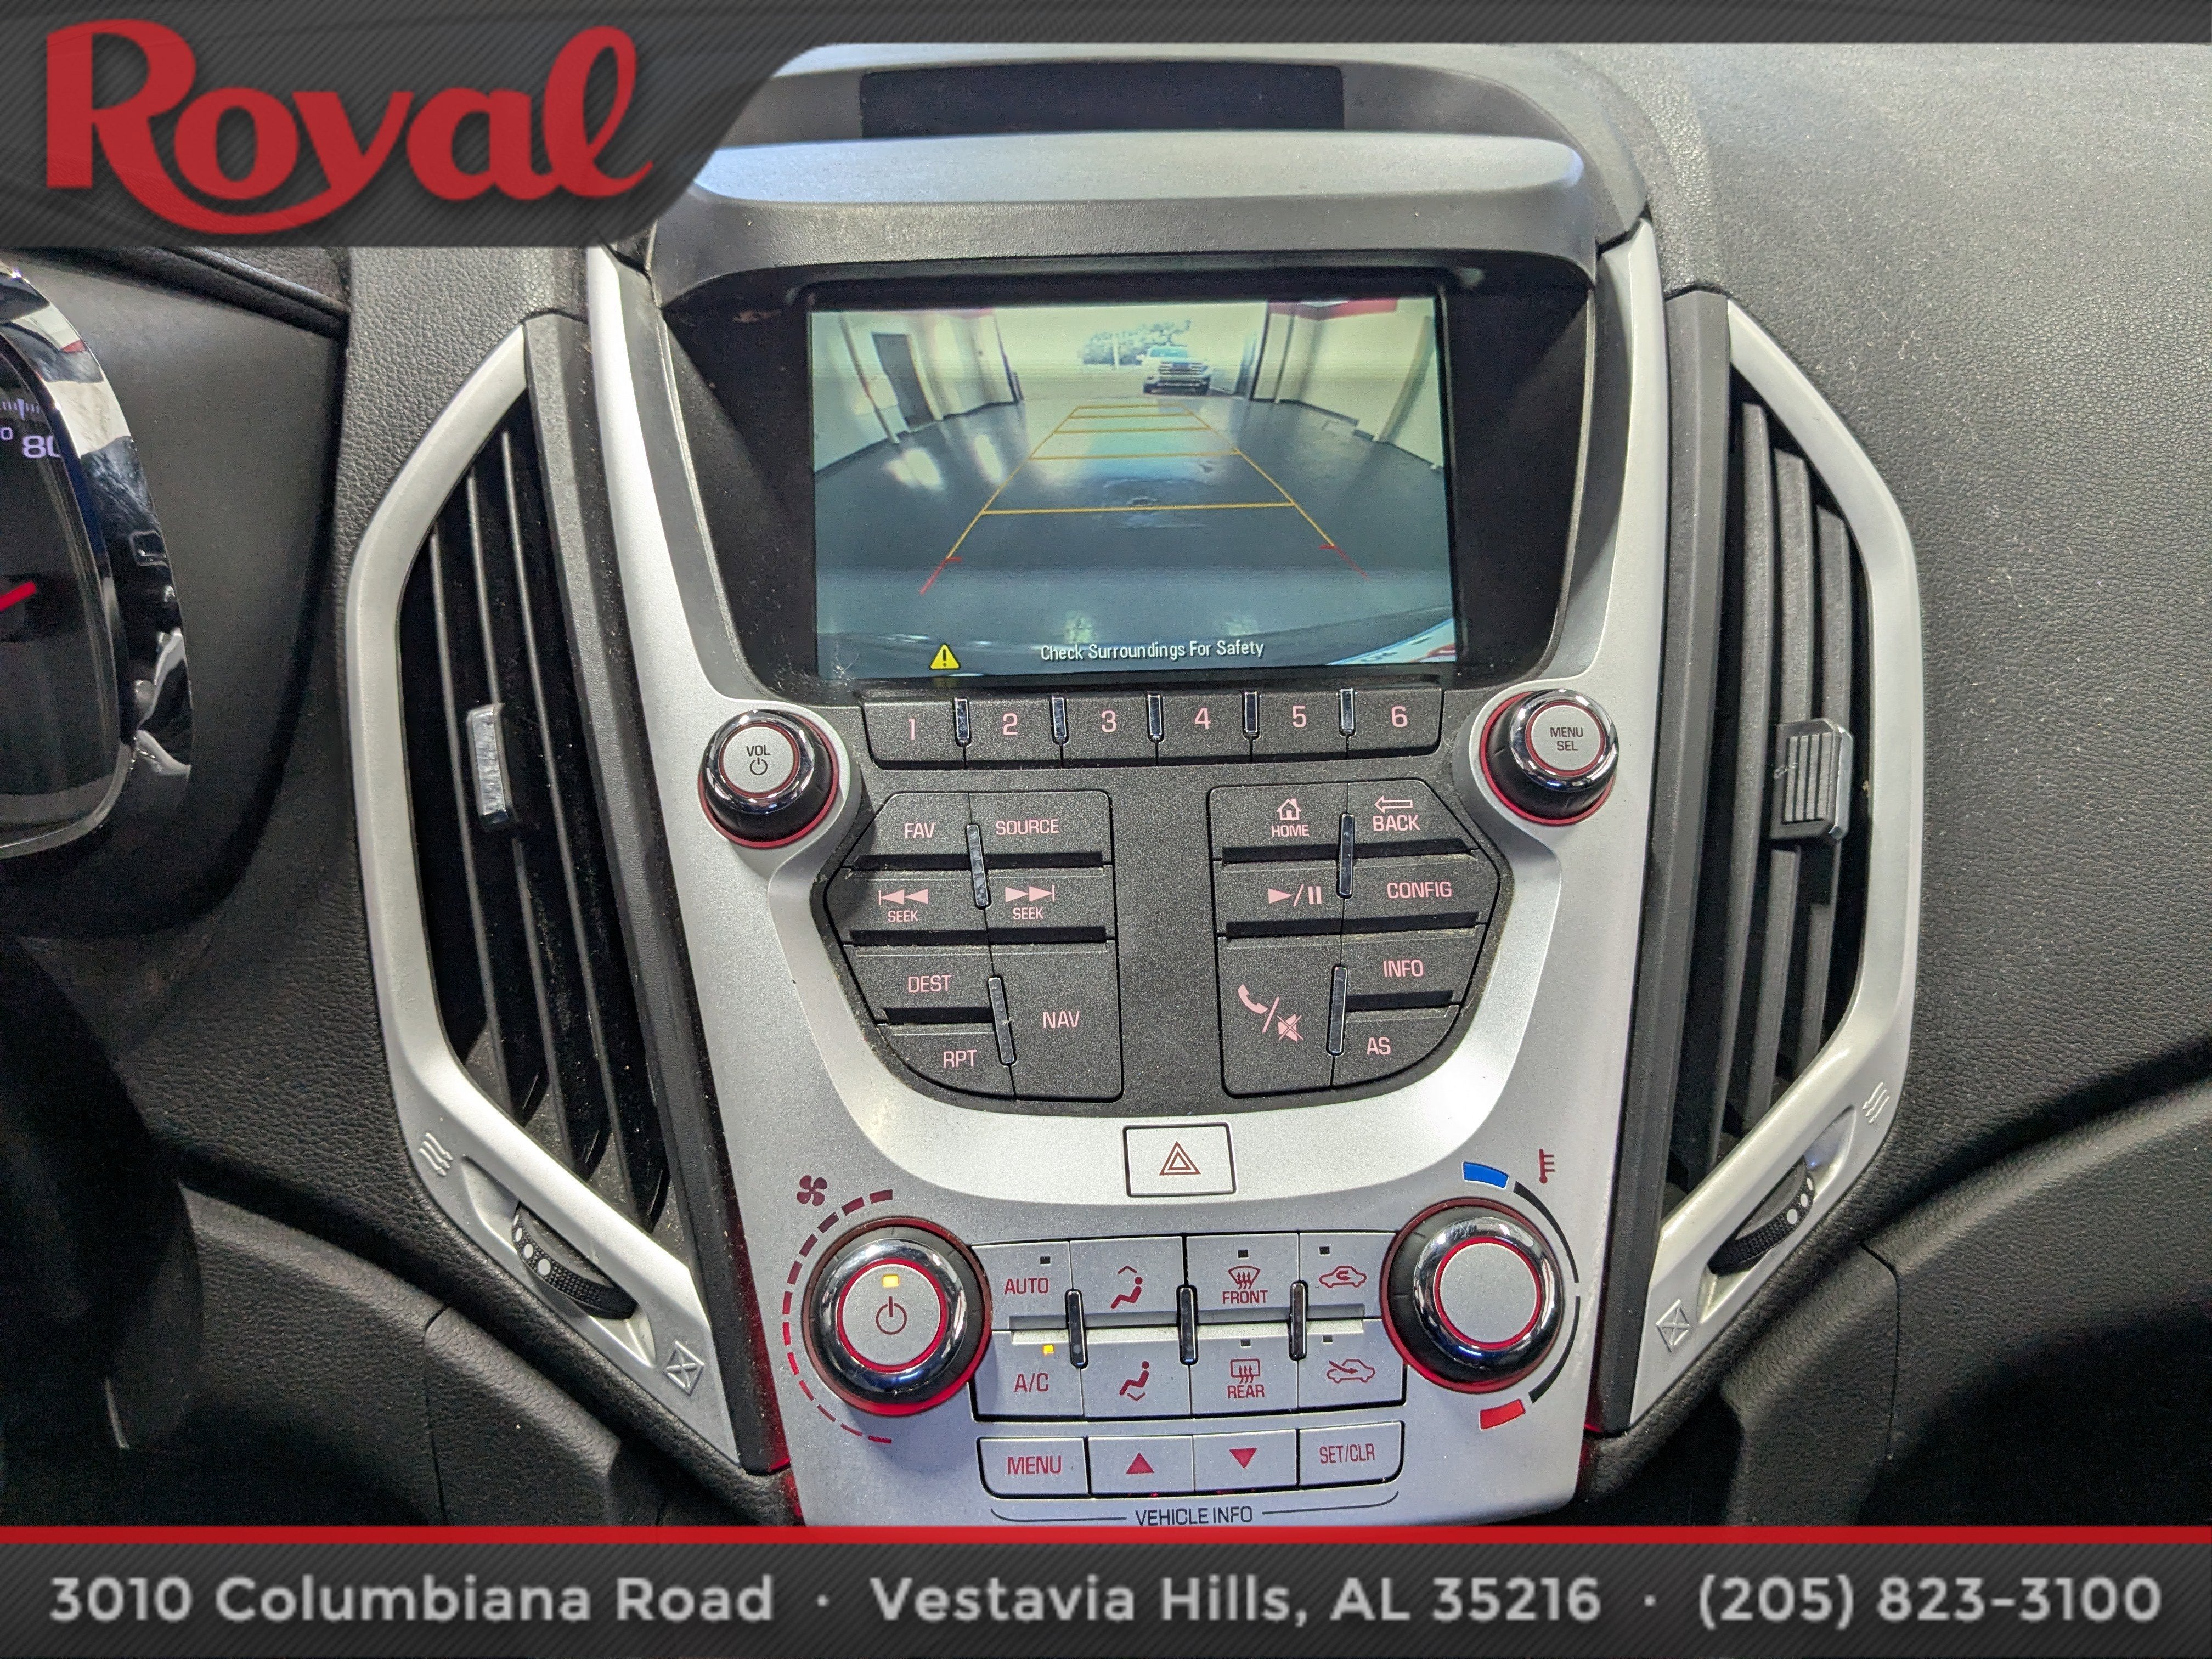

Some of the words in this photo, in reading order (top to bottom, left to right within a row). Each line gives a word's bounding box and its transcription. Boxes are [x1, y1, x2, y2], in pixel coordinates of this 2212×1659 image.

[1041, 644, 1084, 661] Check
[1089, 640, 1186, 661] Surroundings
[1190, 641, 1211, 657] For
[1216, 639, 1265, 658] Safety
[1003, 713, 1018, 735] 2
[1102, 711, 1117, 732] 3
[1194, 708, 1211, 730] 4
[1293, 706, 1306, 727] 5
[1392, 706, 1407, 727] 6
[908, 719, 917, 741] 1
[1550, 727, 1584, 738] MENU
[746, 744, 771, 757] VOL
[1556, 740, 1578, 752] SEL
[905, 822, 935, 838] FAV
[996, 819, 1059, 835] SOURCE
[1271, 823, 1310, 838] HOME
[1373, 815, 1420, 832] BACK
[1387, 882, 1452, 899] CONFIG
[888, 910, 919, 923] SEEK
[1013, 907, 1044, 920] SEEK
[1383, 960, 1424, 977] INFO
[907, 974, 952, 992] DEST
[1043, 1011, 1080, 1028] NAV
[1366, 1038, 1391, 1056] AS
[943, 1050, 977, 1068] RPT
[1004, 1278, 1049, 1295] AUTO
[1222, 1290, 1268, 1304] FRONT
[1014, 1373, 1049, 1392] A/C
[1227, 1384, 1265, 1398] REAR
[1319, 1443, 1375, 1464] SET/CLR
[1007, 1455, 1062, 1475] MENU
[1136, 1507, 1208, 1526] VEHICLE
[1212, 1505, 1253, 1523] INFO
